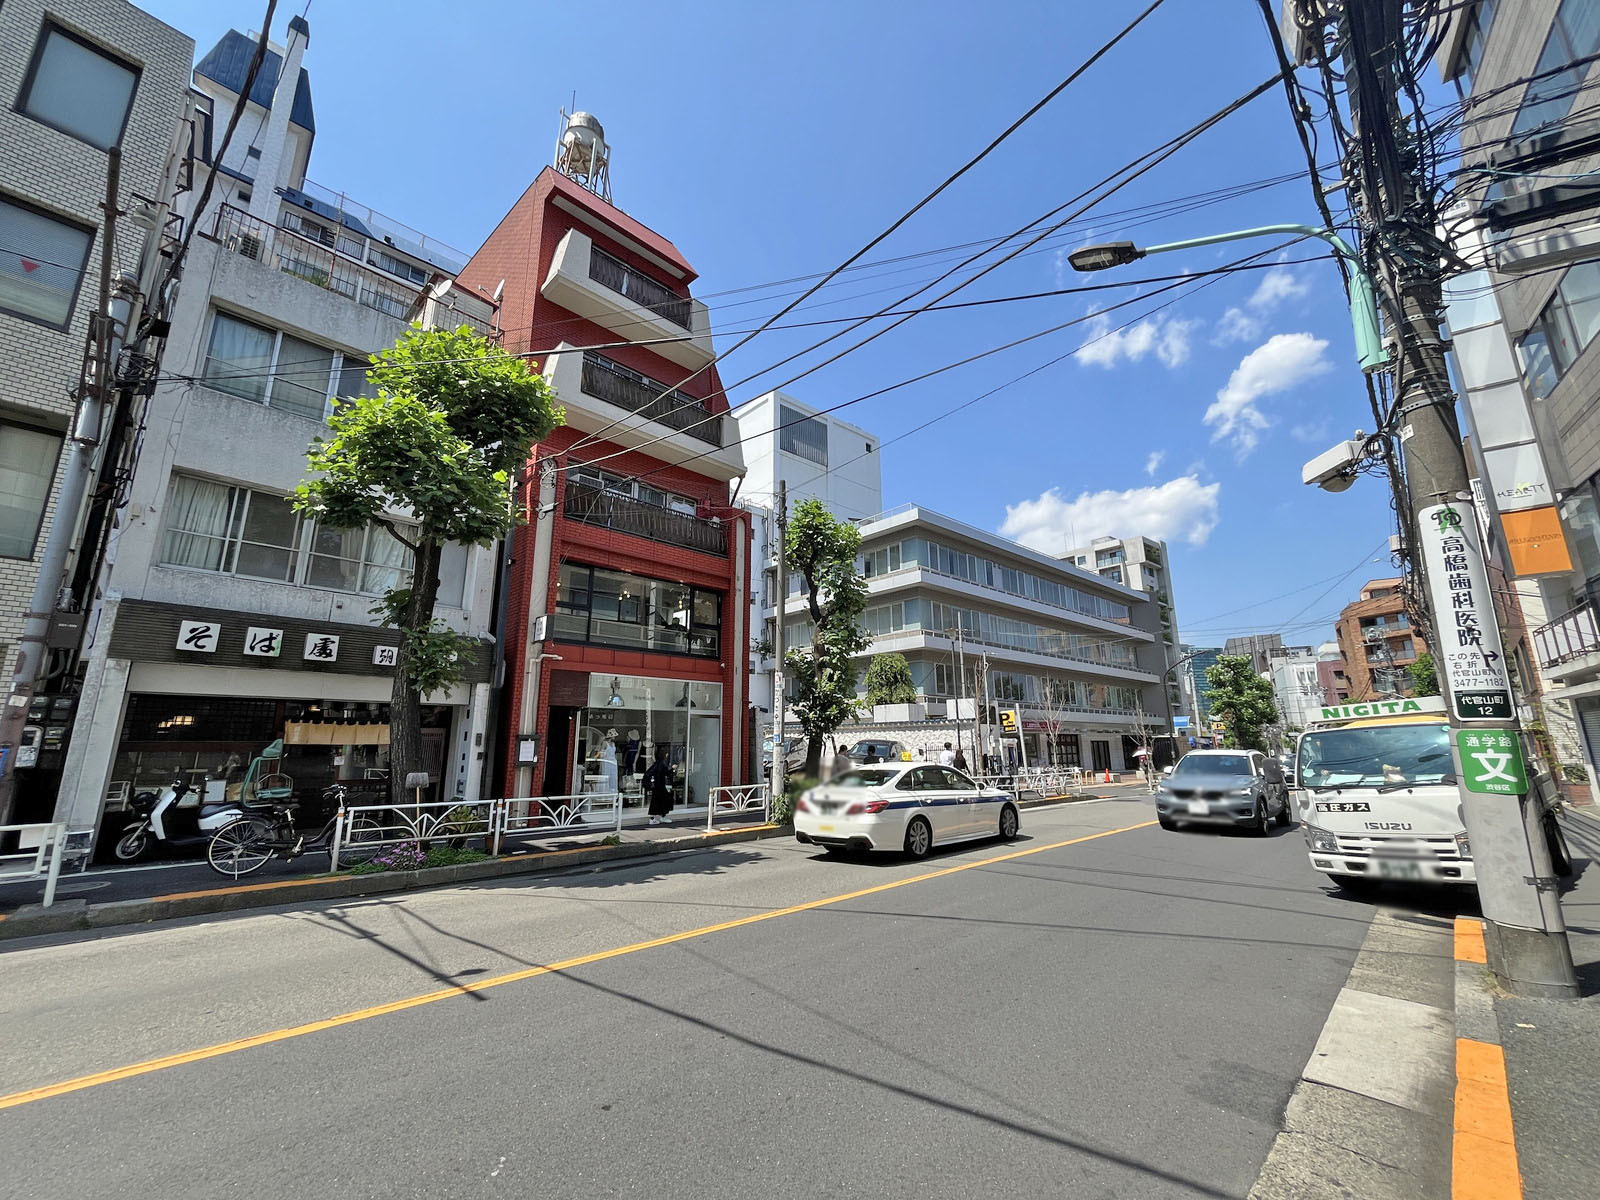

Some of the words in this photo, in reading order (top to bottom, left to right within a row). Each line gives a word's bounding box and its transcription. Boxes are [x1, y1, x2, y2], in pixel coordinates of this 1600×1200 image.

[1497, 483, 1546, 498] HEARTY
[1440, 536, 1484, 647] 高橋歯科医院
[1448, 652, 1480, 661] この先
[1453, 661, 1477, 669] 右折
[1454, 678, 1504, 687] 3477-1182
[1461, 696, 1504, 705] 代官山町
[1321, 700, 1422, 719] NIGITA
[1478, 706, 1493, 715] 12
[999, 713, 1010, 725] P
[1465, 736, 1512, 747] 通学路
[1470, 748, 1518, 782] 文
[1485, 783, 1511, 791] 渋谷区
[1317, 803, 1368, 812] 高圧ガス
[1364, 822, 1413, 830] ISUZU
